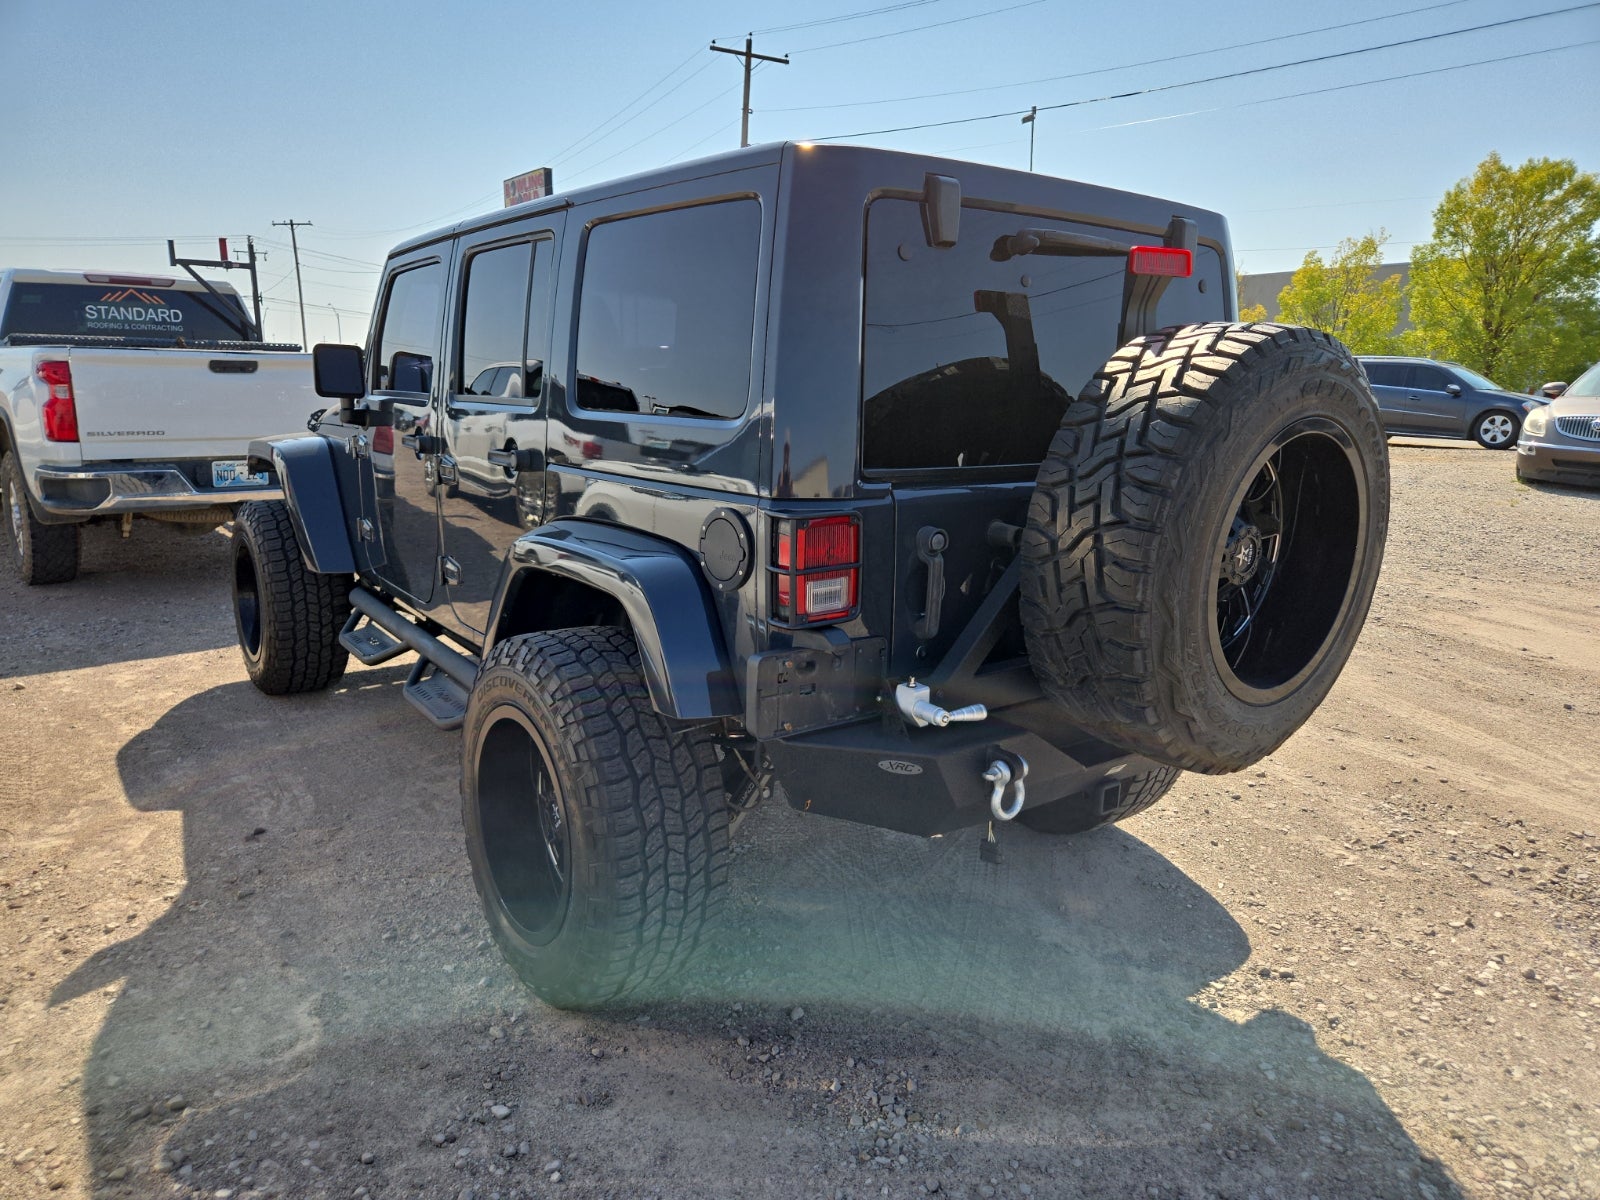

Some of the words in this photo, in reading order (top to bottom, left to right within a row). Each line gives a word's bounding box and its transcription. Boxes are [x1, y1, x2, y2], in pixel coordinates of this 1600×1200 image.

[85, 305, 183, 322] STANDARD
[87, 322, 123, 330] ROOFING
[131, 323, 184, 331] CONTRACTING
[886, 761, 915, 772] XRC
